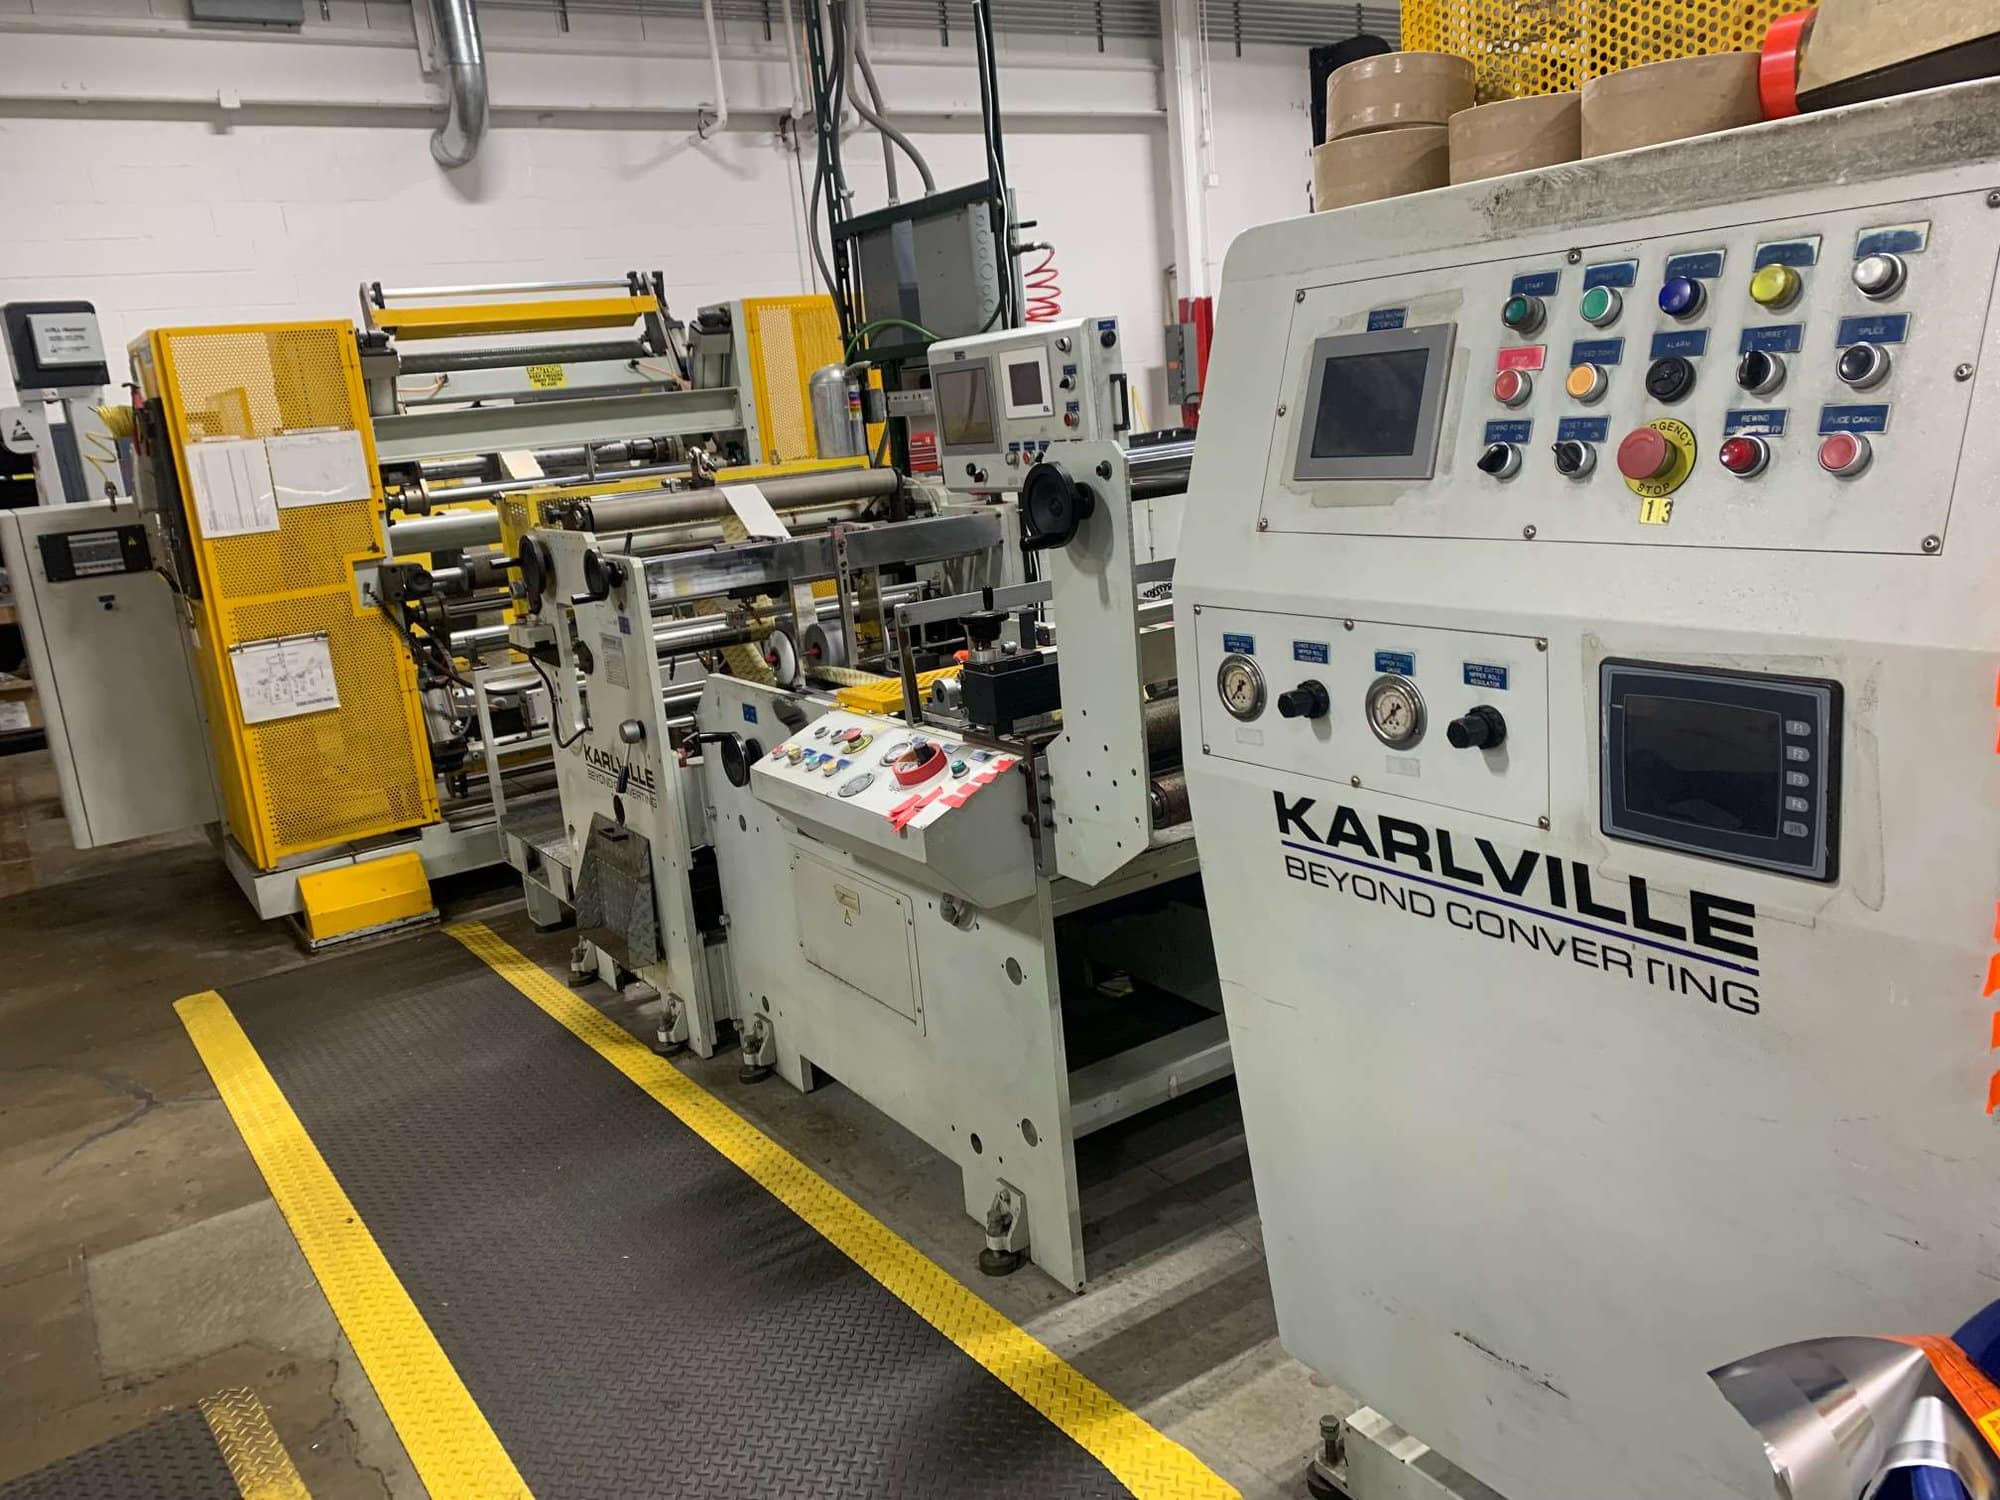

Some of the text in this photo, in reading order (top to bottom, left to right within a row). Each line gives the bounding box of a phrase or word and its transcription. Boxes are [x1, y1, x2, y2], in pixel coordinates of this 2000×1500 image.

[1636, 482, 1671, 496] STOP
[1273, 790, 1760, 961] KARLVILLE
[1284, 854, 1436, 918] BEYOND
